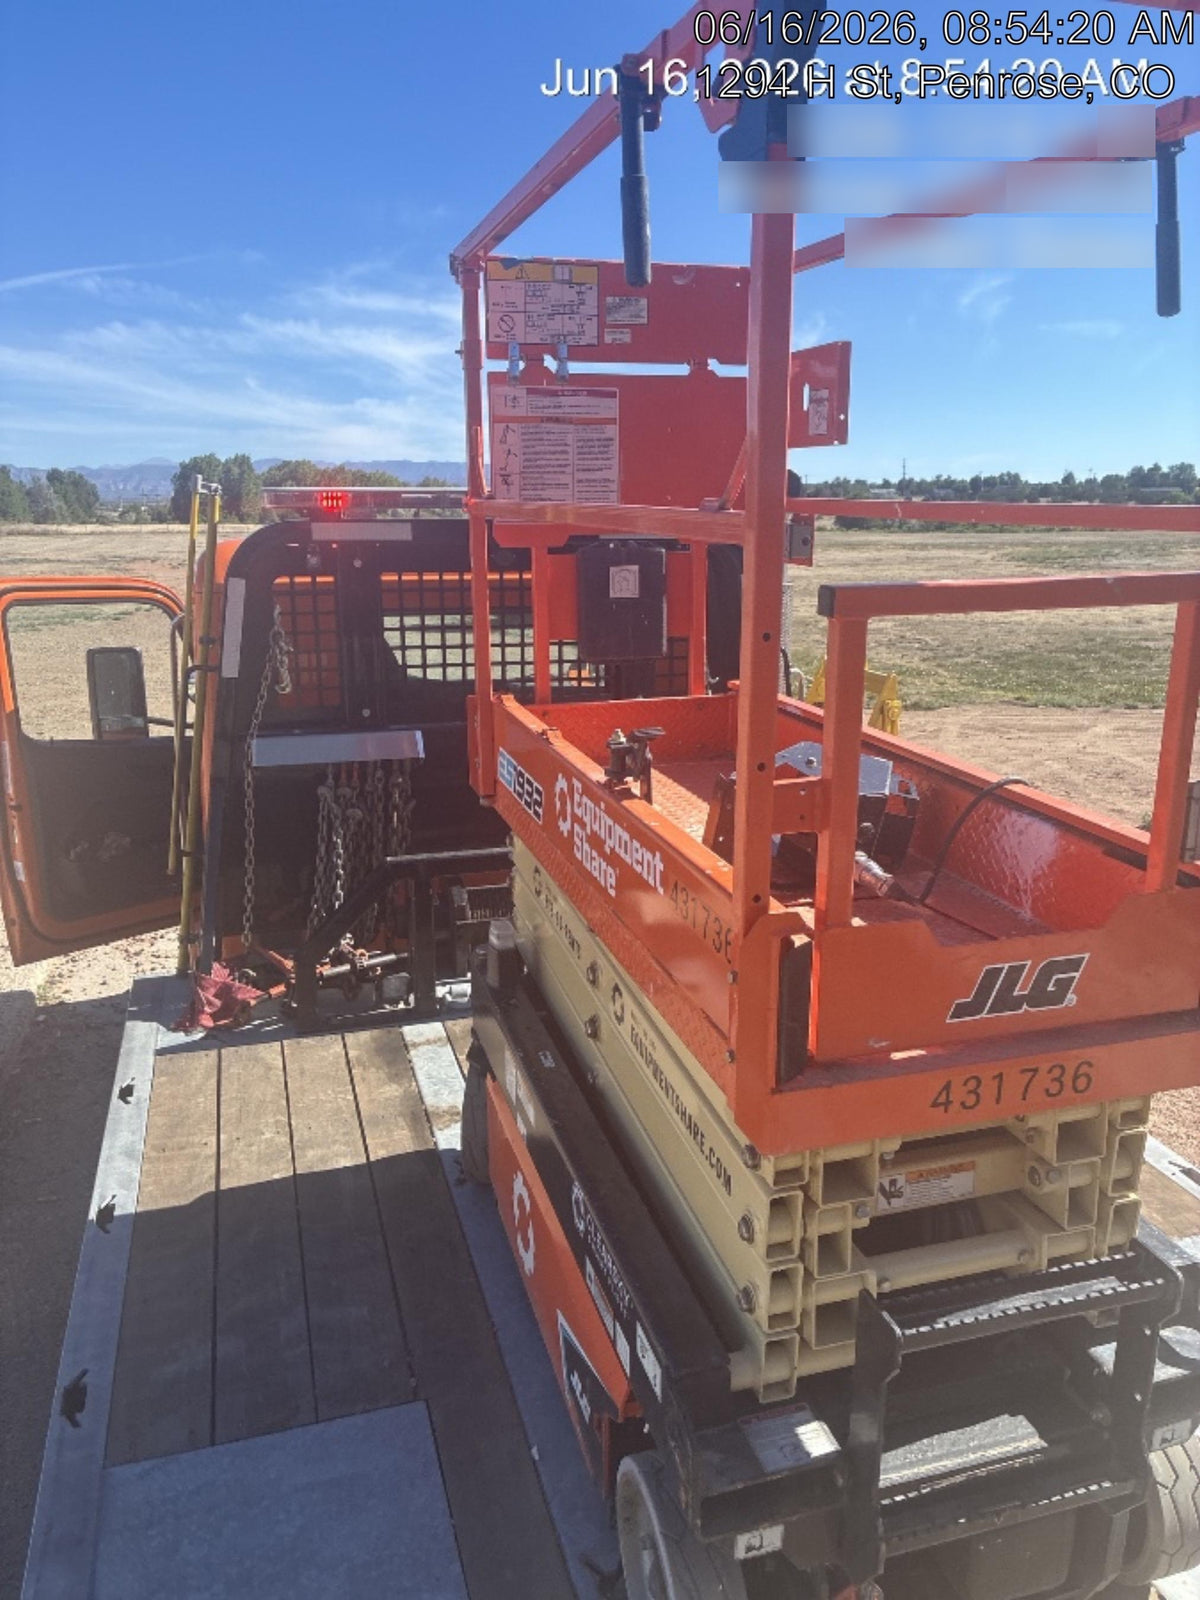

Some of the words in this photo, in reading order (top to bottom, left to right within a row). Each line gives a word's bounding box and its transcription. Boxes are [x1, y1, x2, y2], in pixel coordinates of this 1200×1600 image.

[573, 776, 664, 896] Equipment
[574, 822, 616, 898] Share
[946, 953, 1090, 1022] JLG
[929, 1060, 1095, 1113] 431736
